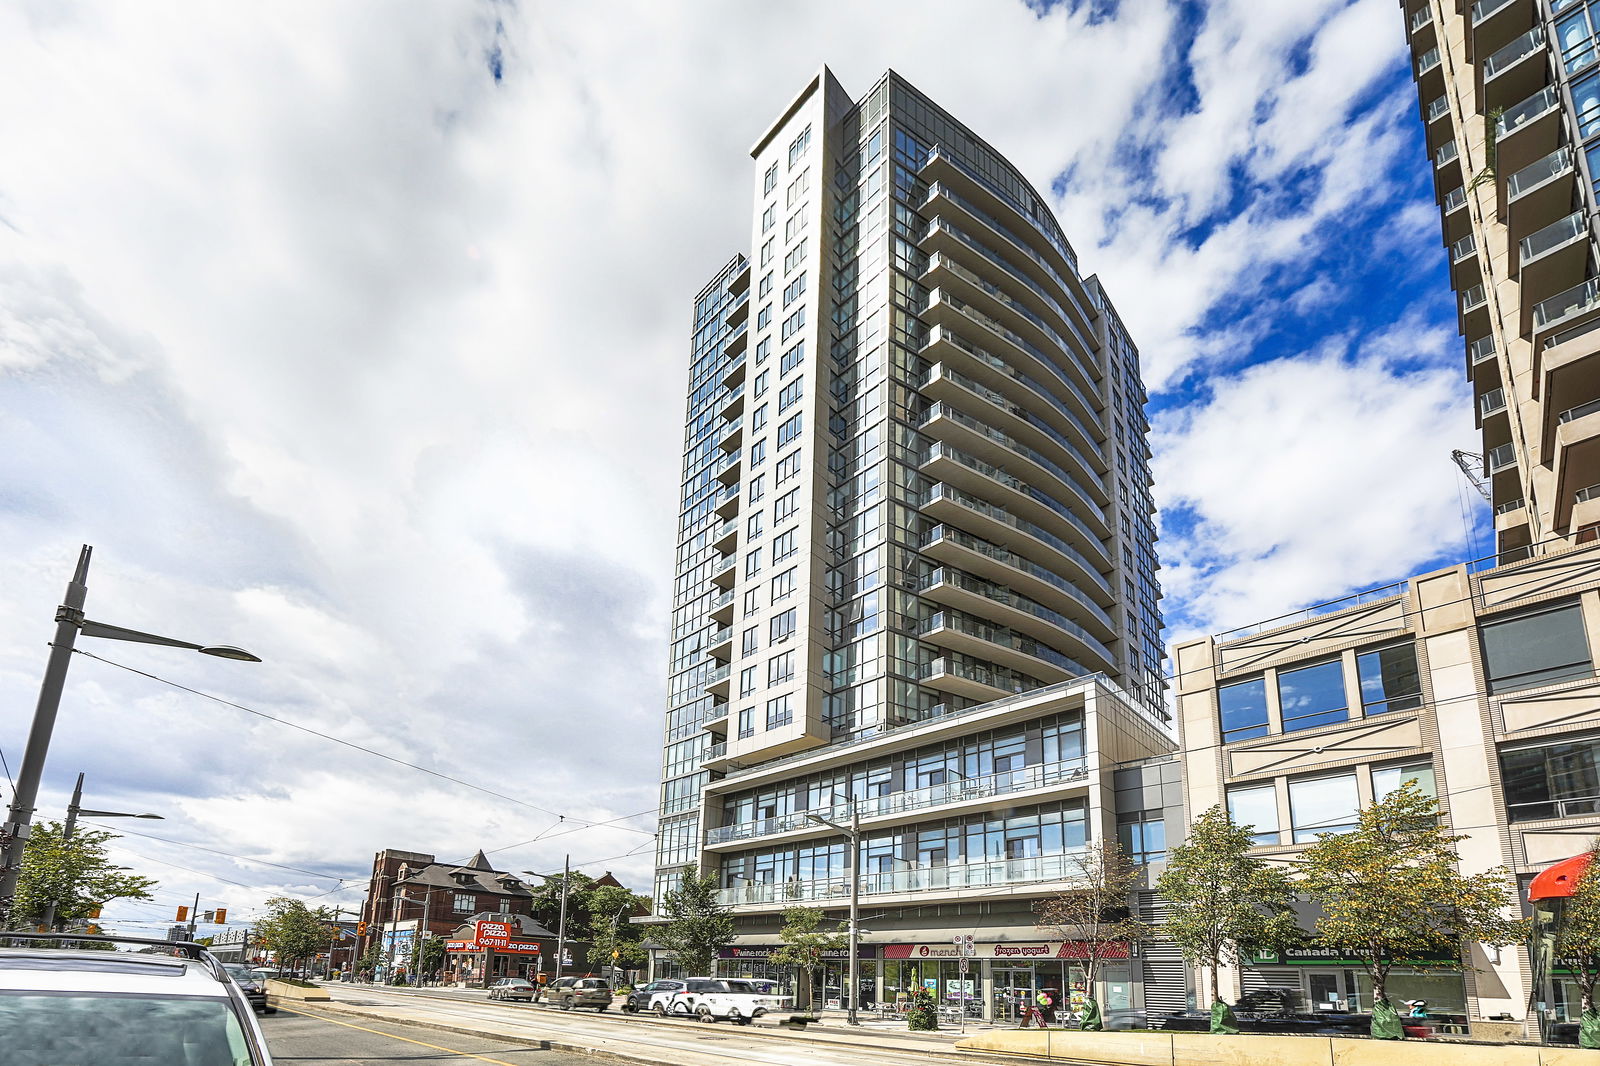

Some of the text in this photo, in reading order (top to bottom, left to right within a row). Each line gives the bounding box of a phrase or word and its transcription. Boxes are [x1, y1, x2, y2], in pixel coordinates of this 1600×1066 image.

[480, 922, 505, 931] pizza
[483, 930, 508, 938] pizza
[518, 944, 539, 952] pizza
[994, 944, 1050, 956] frozen yogurt
[1285, 947, 1339, 957] Canada
